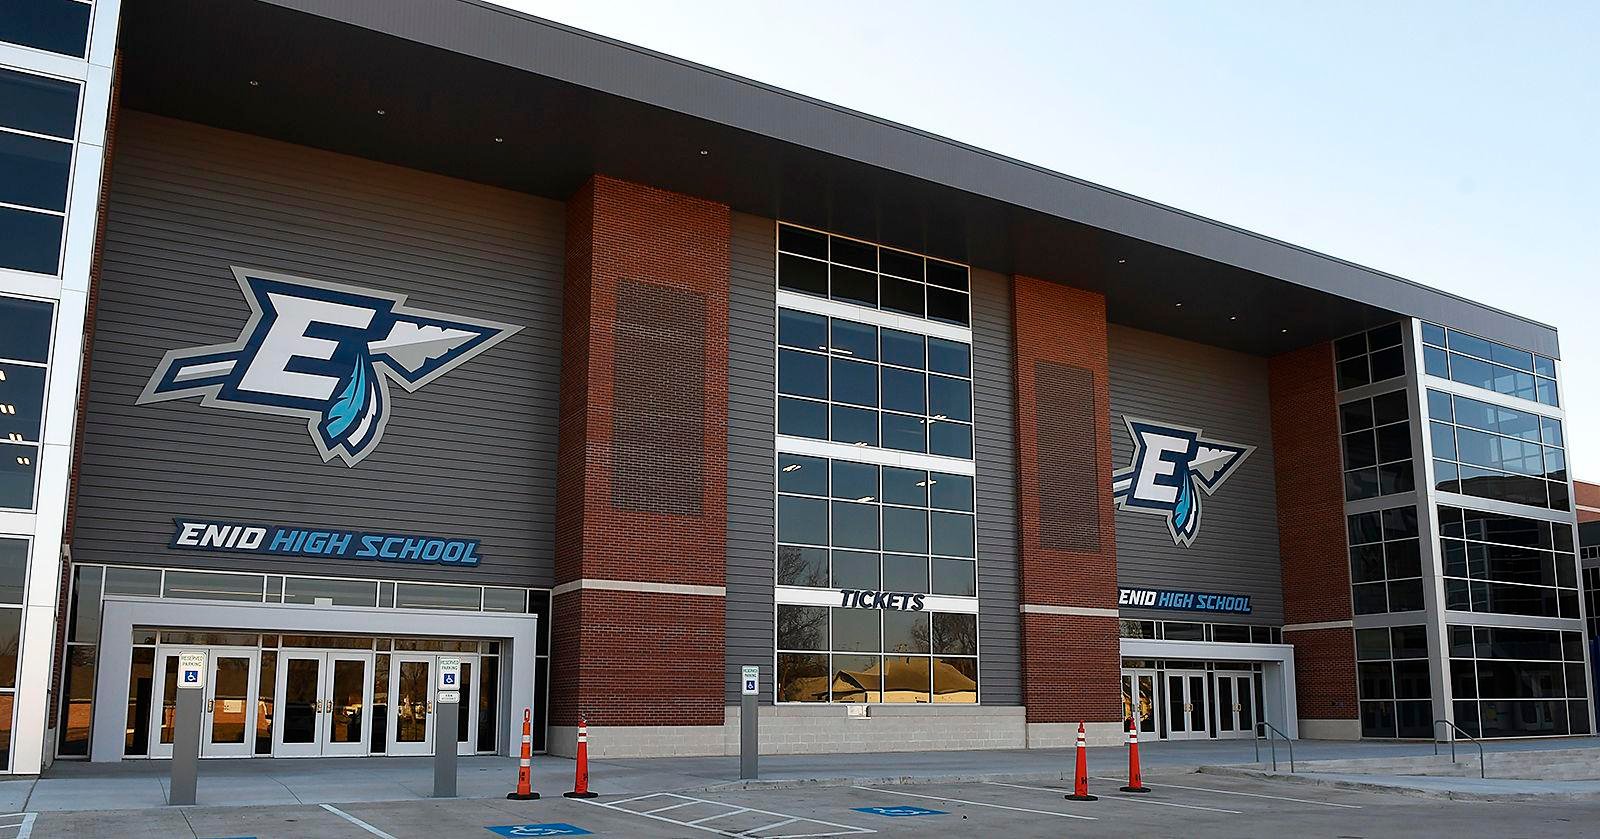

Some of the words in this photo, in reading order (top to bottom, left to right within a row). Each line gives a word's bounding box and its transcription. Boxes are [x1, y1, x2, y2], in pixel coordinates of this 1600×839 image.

[176, 522, 267, 550] ENID
[269, 529, 353, 556] HIGH
[356, 536, 478, 563] SCHOOL
[840, 589, 926, 612] TICKETS
[1119, 589, 1157, 606] ENID
[1158, 592, 1194, 608] HIGH
[1196, 594, 1251, 612] SCHOOL
